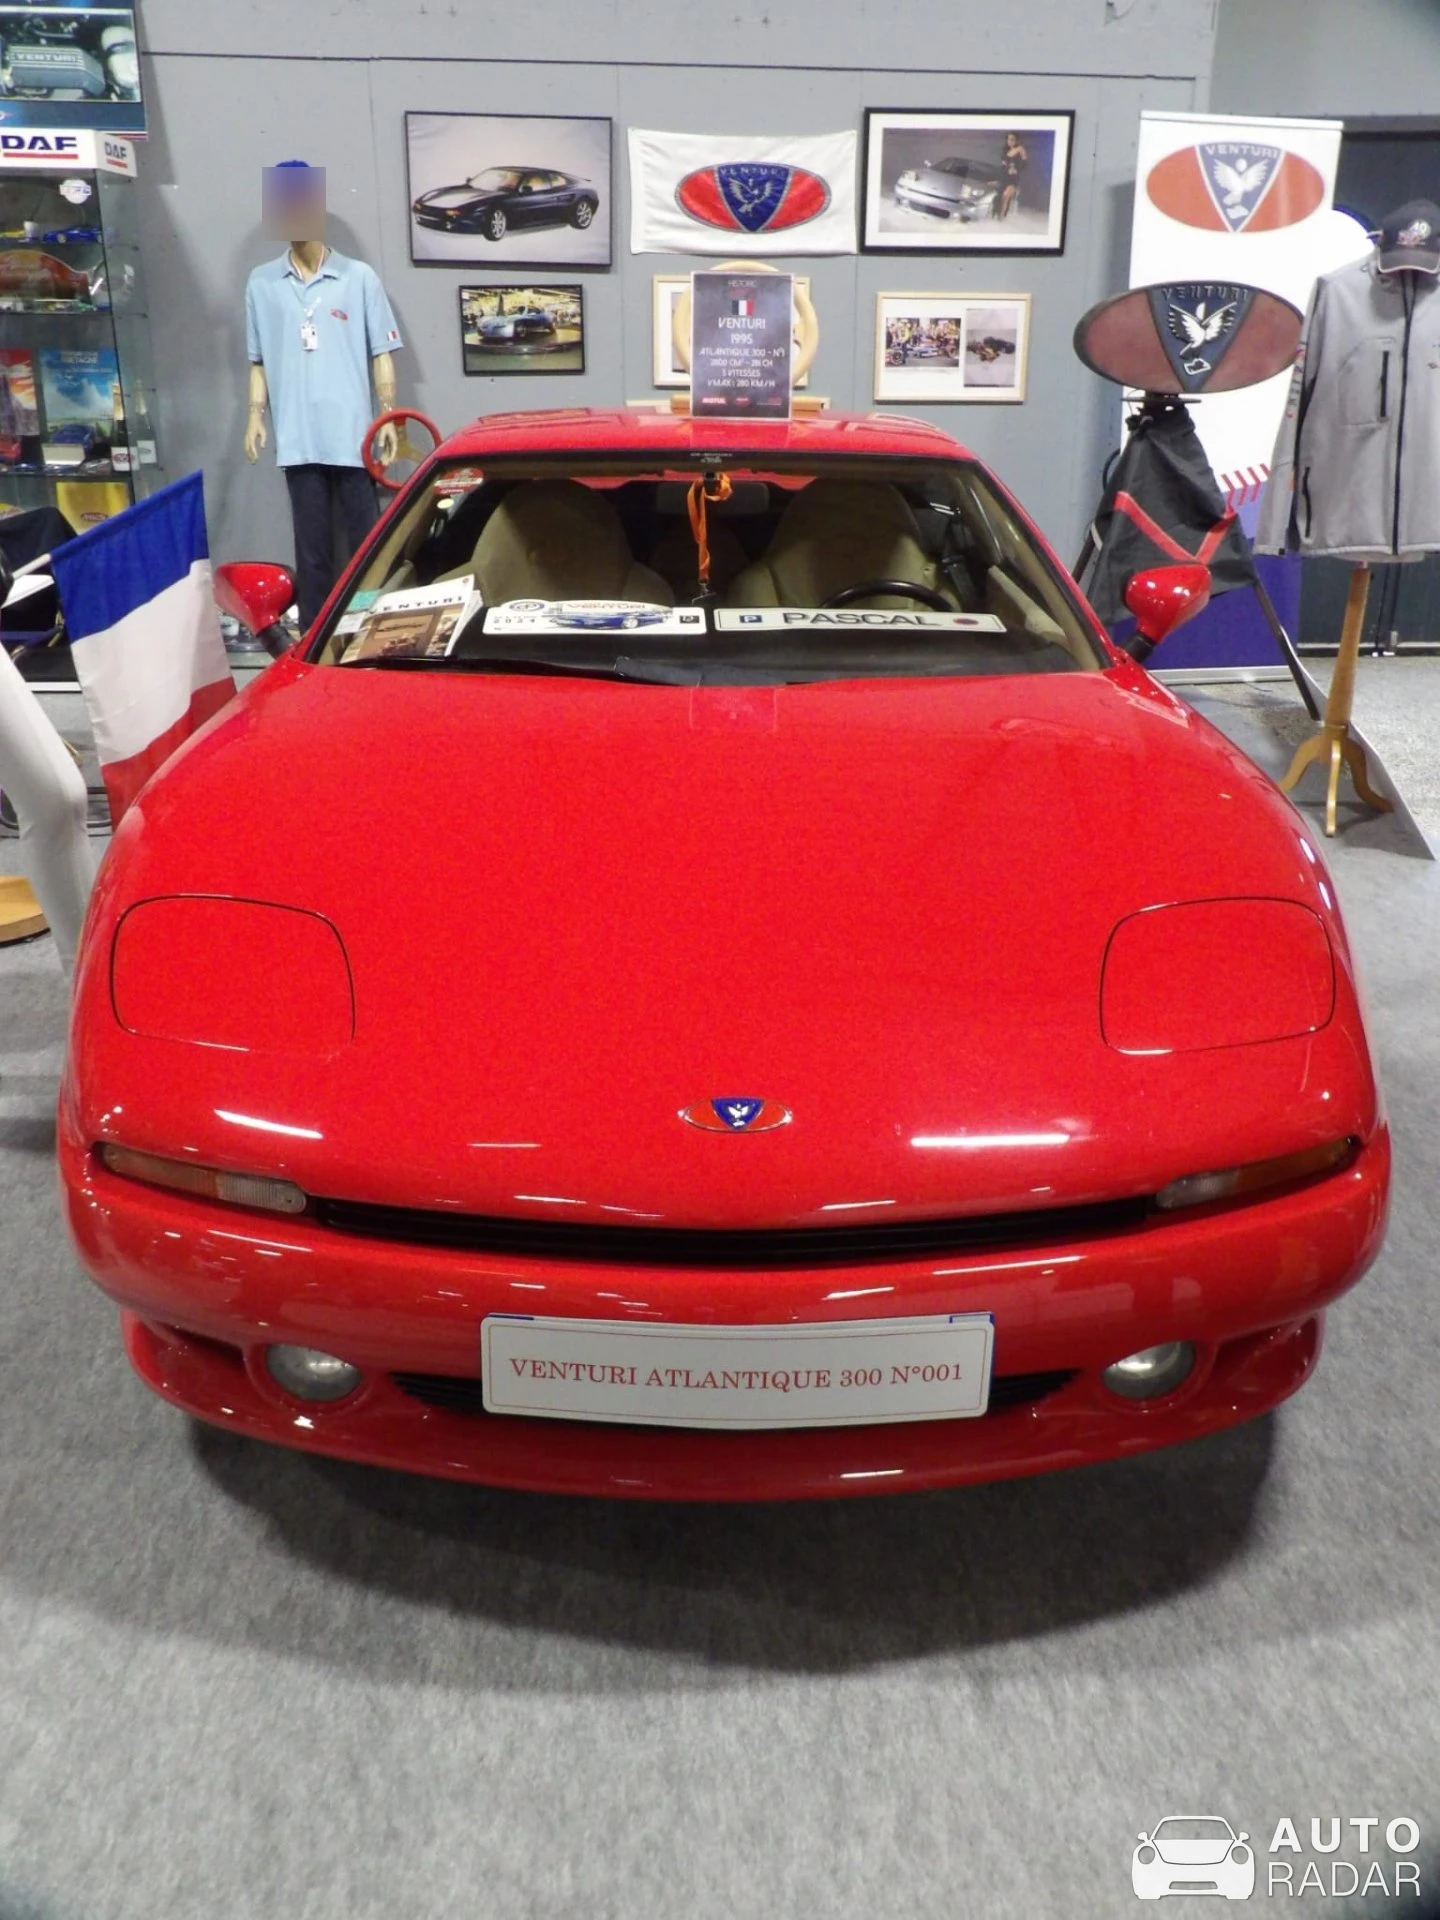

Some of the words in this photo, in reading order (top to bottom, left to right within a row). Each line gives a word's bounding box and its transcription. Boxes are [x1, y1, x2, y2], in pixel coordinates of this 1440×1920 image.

[15, 53, 76, 62] VENTURI
[1, 135, 76, 151] DAF
[105, 142, 127, 159] DAF
[1205, 144, 1279, 158] VENTURI
[720, 167, 786, 176] VENTURI
[1162, 285, 1248, 300] VENTURI
[718, 317, 766, 329] VENTURI
[730, 333, 753, 345] 1995
[727, 369, 760, 377] VITESSES
[369, 596, 463, 615] VENTURI
[782, 612, 943, 627] PASCAL
[509, 1358, 637, 1385] VENTURI
[646, 1369, 831, 1391] ATLANTIQUE
[840, 1369, 882, 1387] 300
[891, 1363, 963, 1384] N°001
